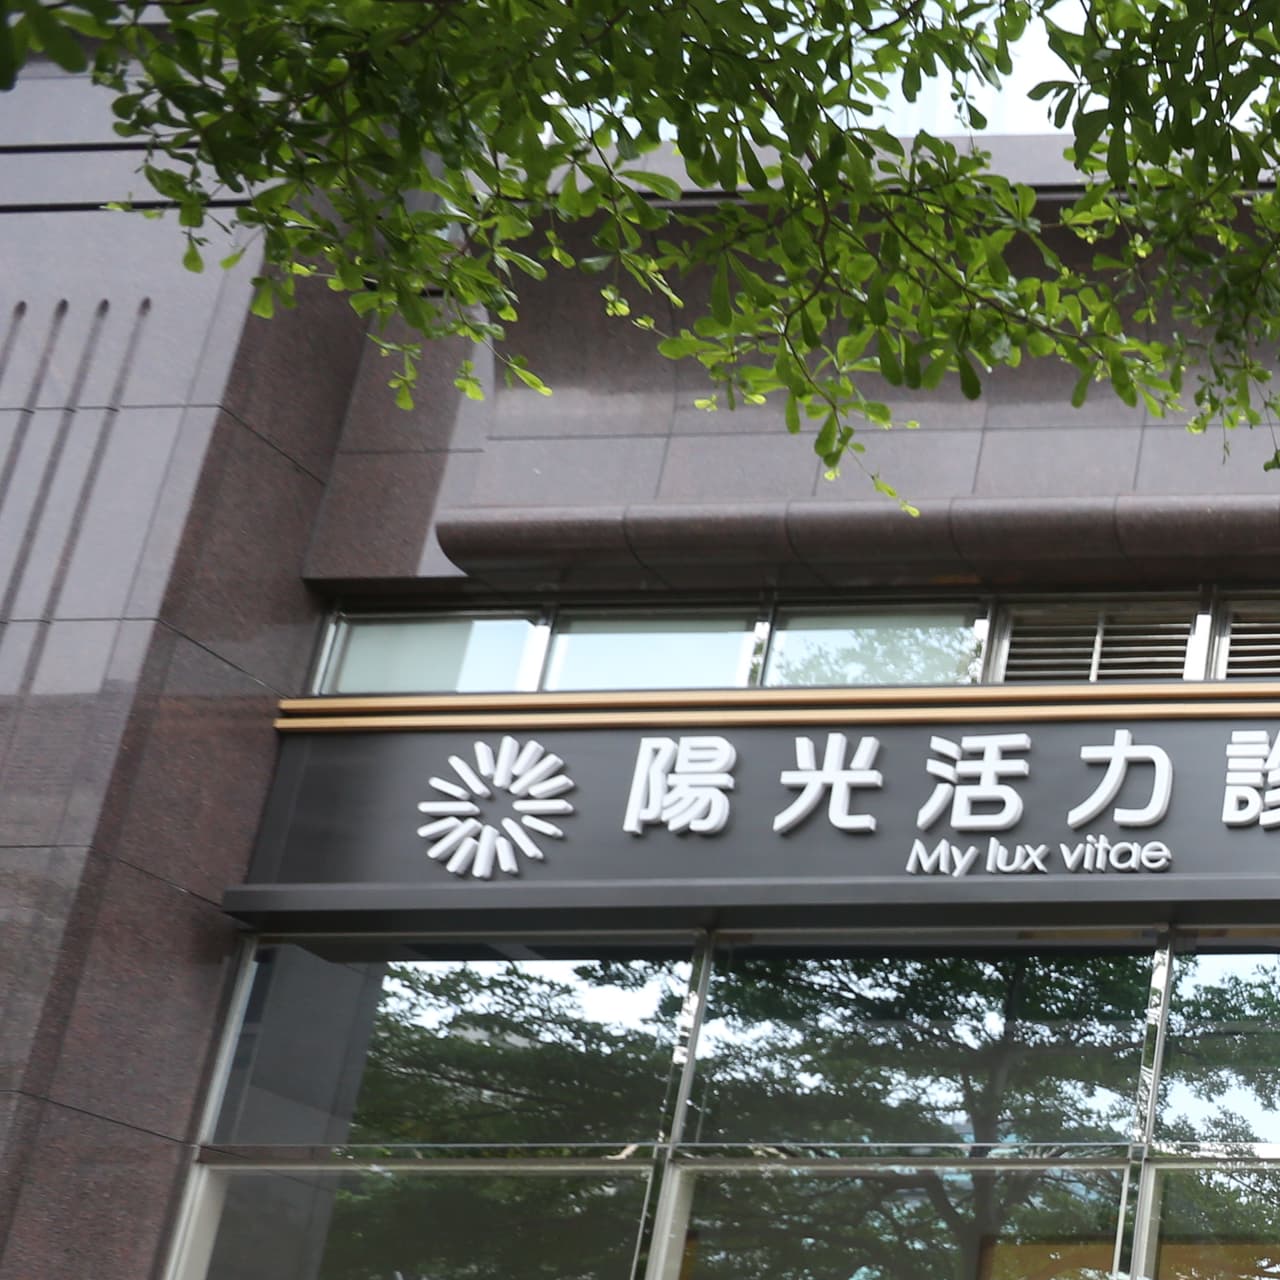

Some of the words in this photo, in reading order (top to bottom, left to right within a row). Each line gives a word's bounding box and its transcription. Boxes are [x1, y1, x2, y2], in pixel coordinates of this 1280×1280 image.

[905, 838, 979, 878] My
[985, 836, 1049, 874] lux
[1059, 834, 1173, 873] vitae
